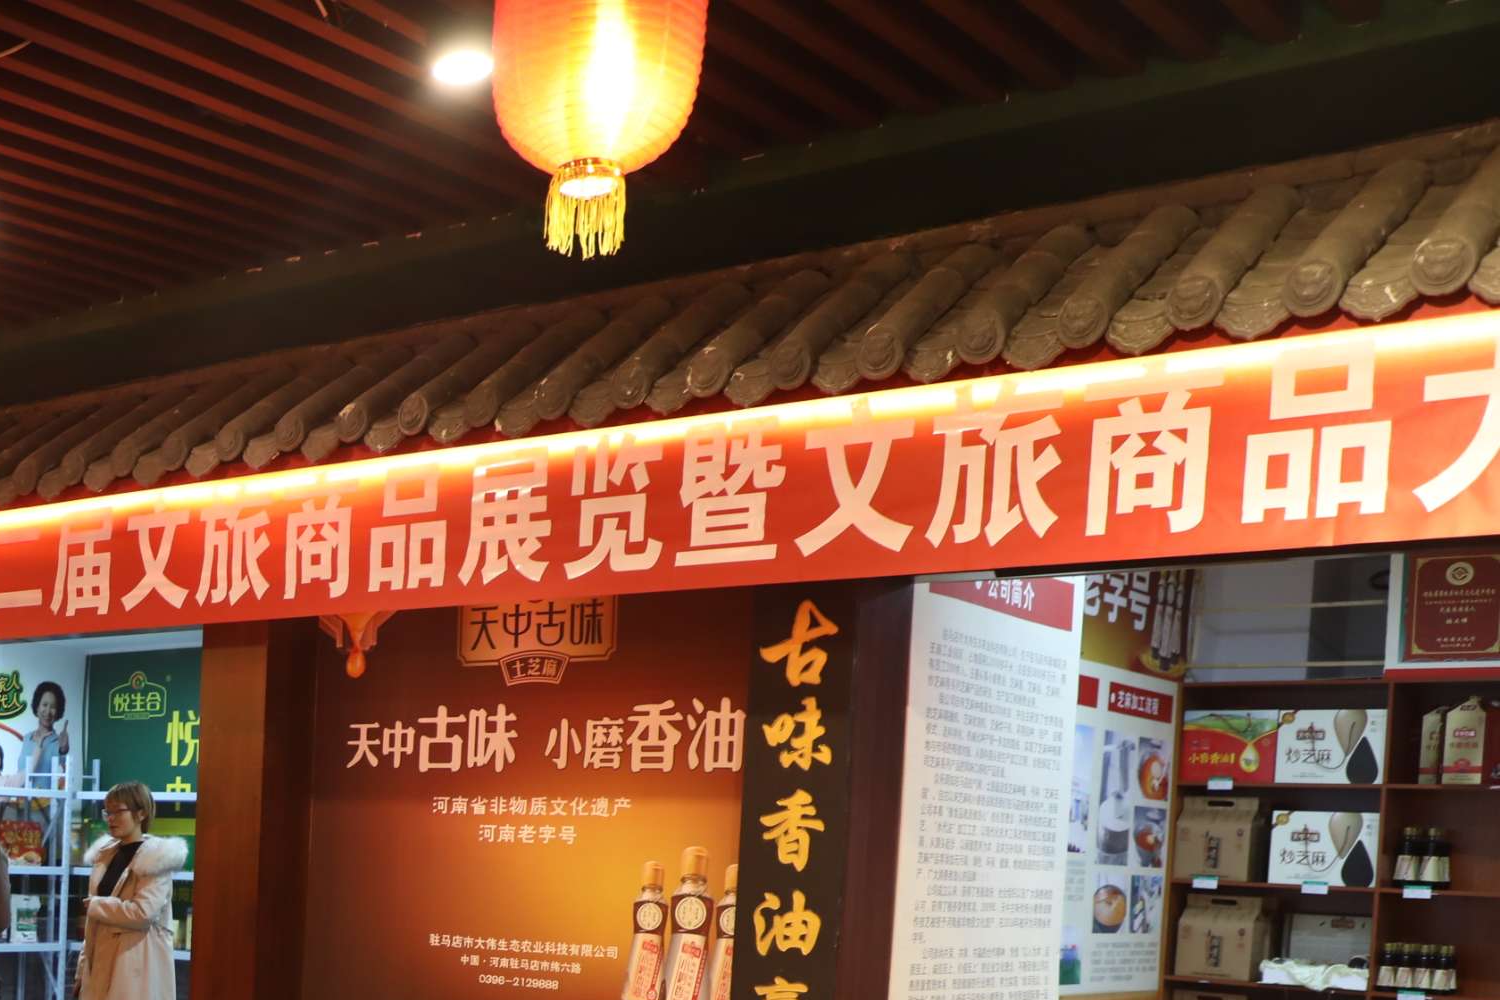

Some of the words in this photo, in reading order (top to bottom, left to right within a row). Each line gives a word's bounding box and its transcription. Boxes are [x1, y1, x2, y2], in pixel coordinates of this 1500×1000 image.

[470, 600, 606, 650] 天中古味
[511, 653, 559, 679] 土芝麻
[113, 691, 162, 713] 悦生合
[345, 704, 519, 774] 天中古味
[544, 695, 747, 774] 小磨香油
[1285, 747, 1333, 765] 炒芝麻
[432, 795, 632, 818] 河南省非物质文化遗产
[478, 823, 578, 846] 河南老字号
[1279, 848, 1326, 866] 炒芝麻
[428, 933, 619, 960] 驻马店市大伟生态农业科技有限公司
[478, 974, 560, 991] 0396-2129888
